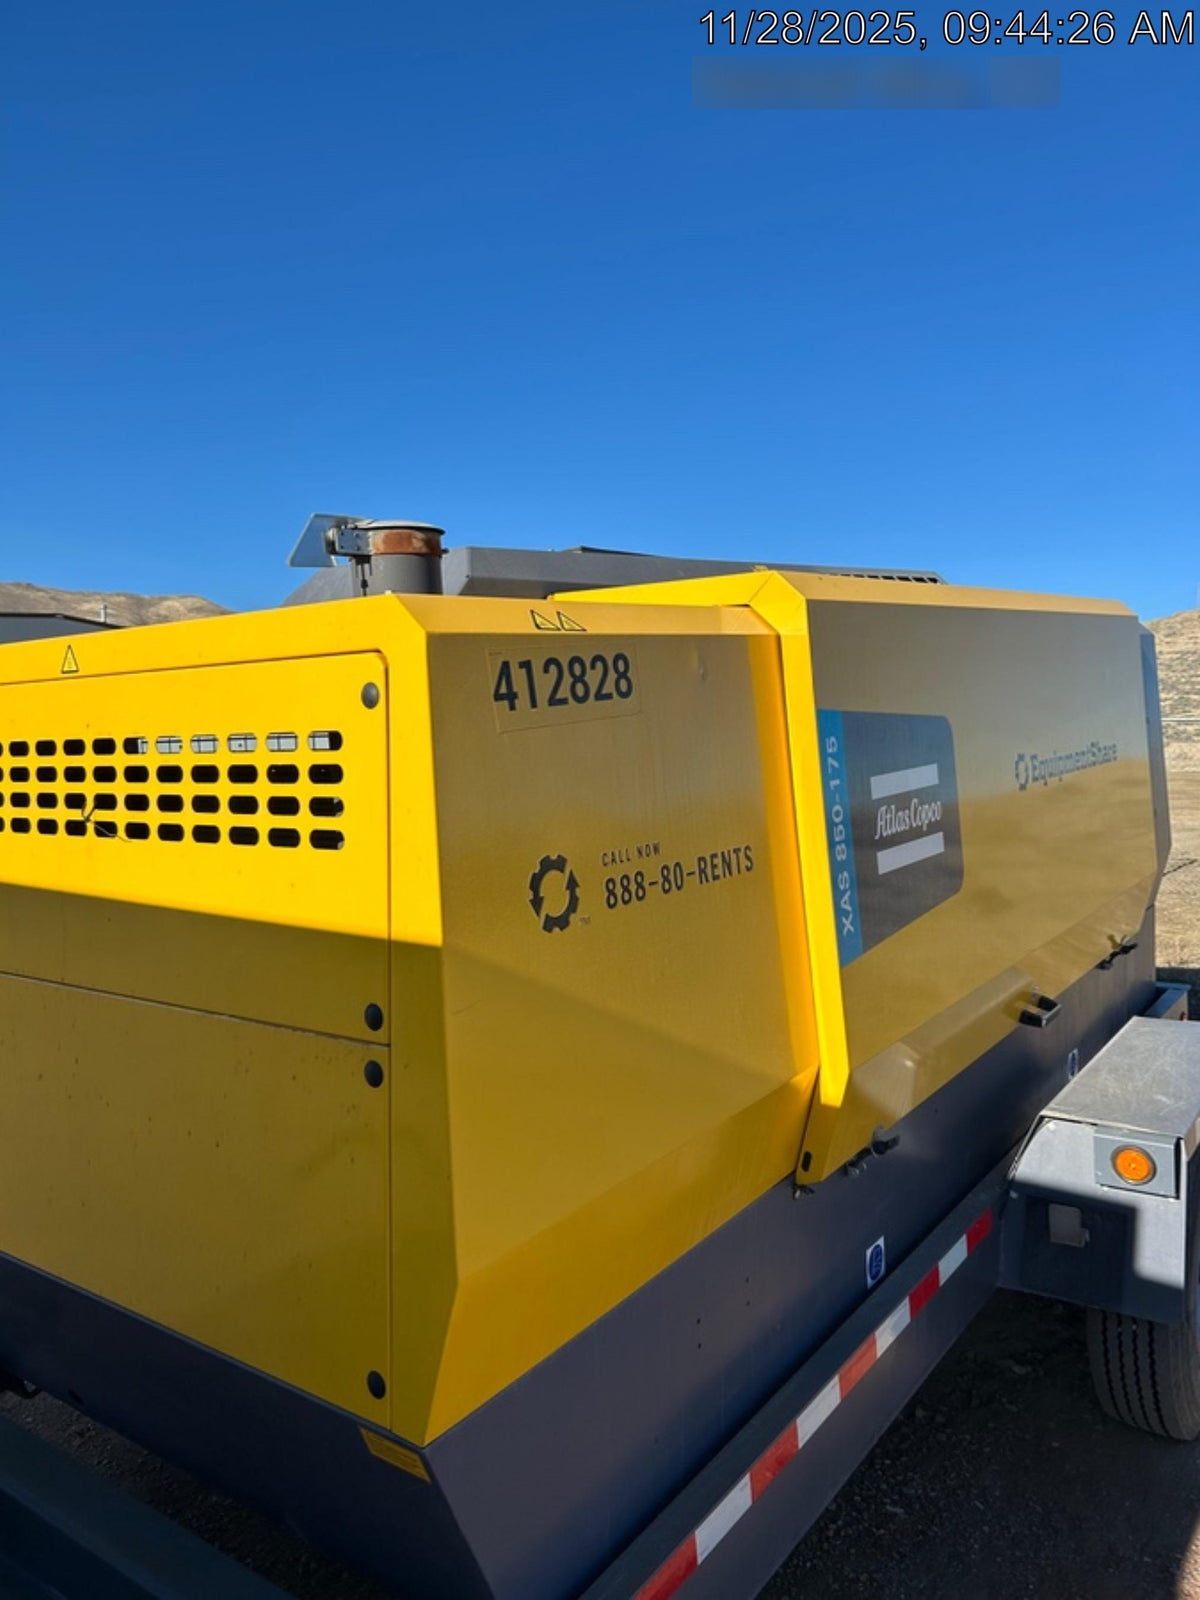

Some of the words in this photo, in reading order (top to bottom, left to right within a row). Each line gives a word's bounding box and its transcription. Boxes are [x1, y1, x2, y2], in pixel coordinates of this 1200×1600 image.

[493, 652, 633, 711] 412828
[1030, 741, 1118, 786] EquipmentShare
[826, 736, 848, 862] 850-175
[874, 804, 909, 840] Atlas
[910, 798, 942, 831] Copco
[602, 848, 631, 867] CALL
[636, 841, 661, 859] NOW
[605, 845, 754, 909] 888-80-RENTS
[839, 871, 855, 936] XAS
